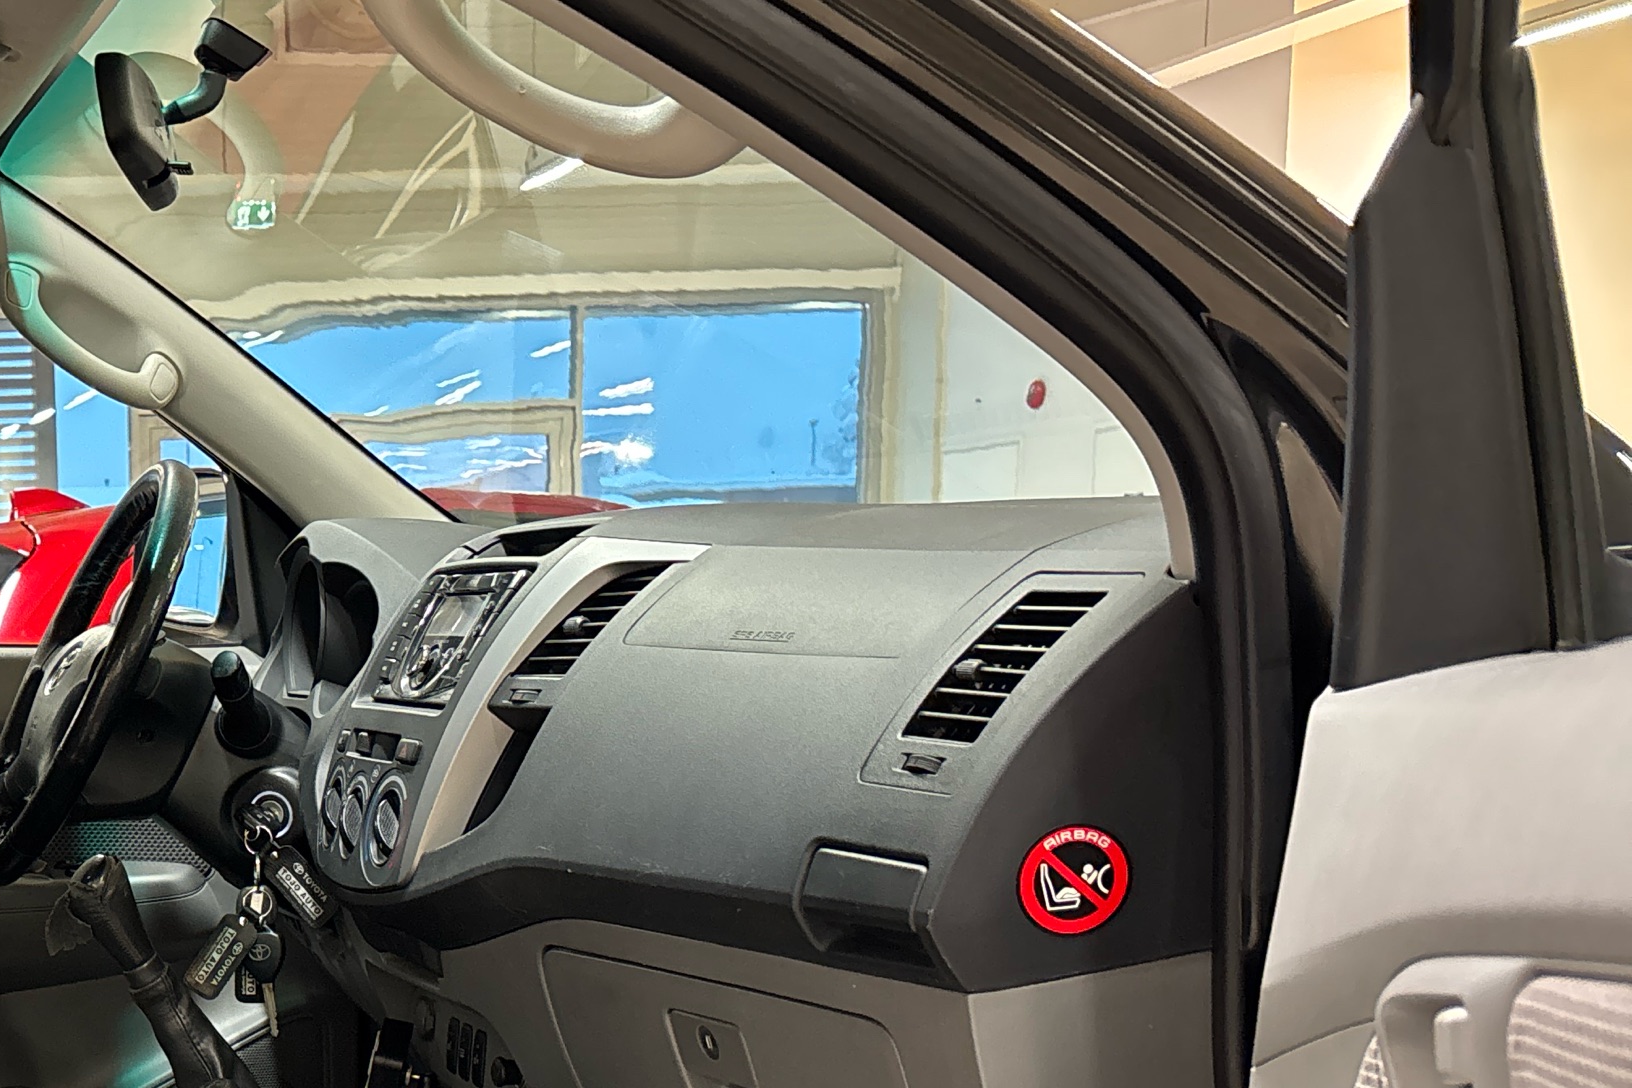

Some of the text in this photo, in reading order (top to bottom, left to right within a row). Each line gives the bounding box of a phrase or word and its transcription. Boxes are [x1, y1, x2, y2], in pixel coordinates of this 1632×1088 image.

[1043, 829, 1111, 851] AIRBAG
[280, 868, 301, 892] TOJO
[300, 892, 322, 915] AUTO
[302, 872, 328, 902] TOYOTA
[215, 930, 236, 955] TOJO
[197, 958, 217, 982] AUTO
[209, 955, 236, 986] TOYOTA
